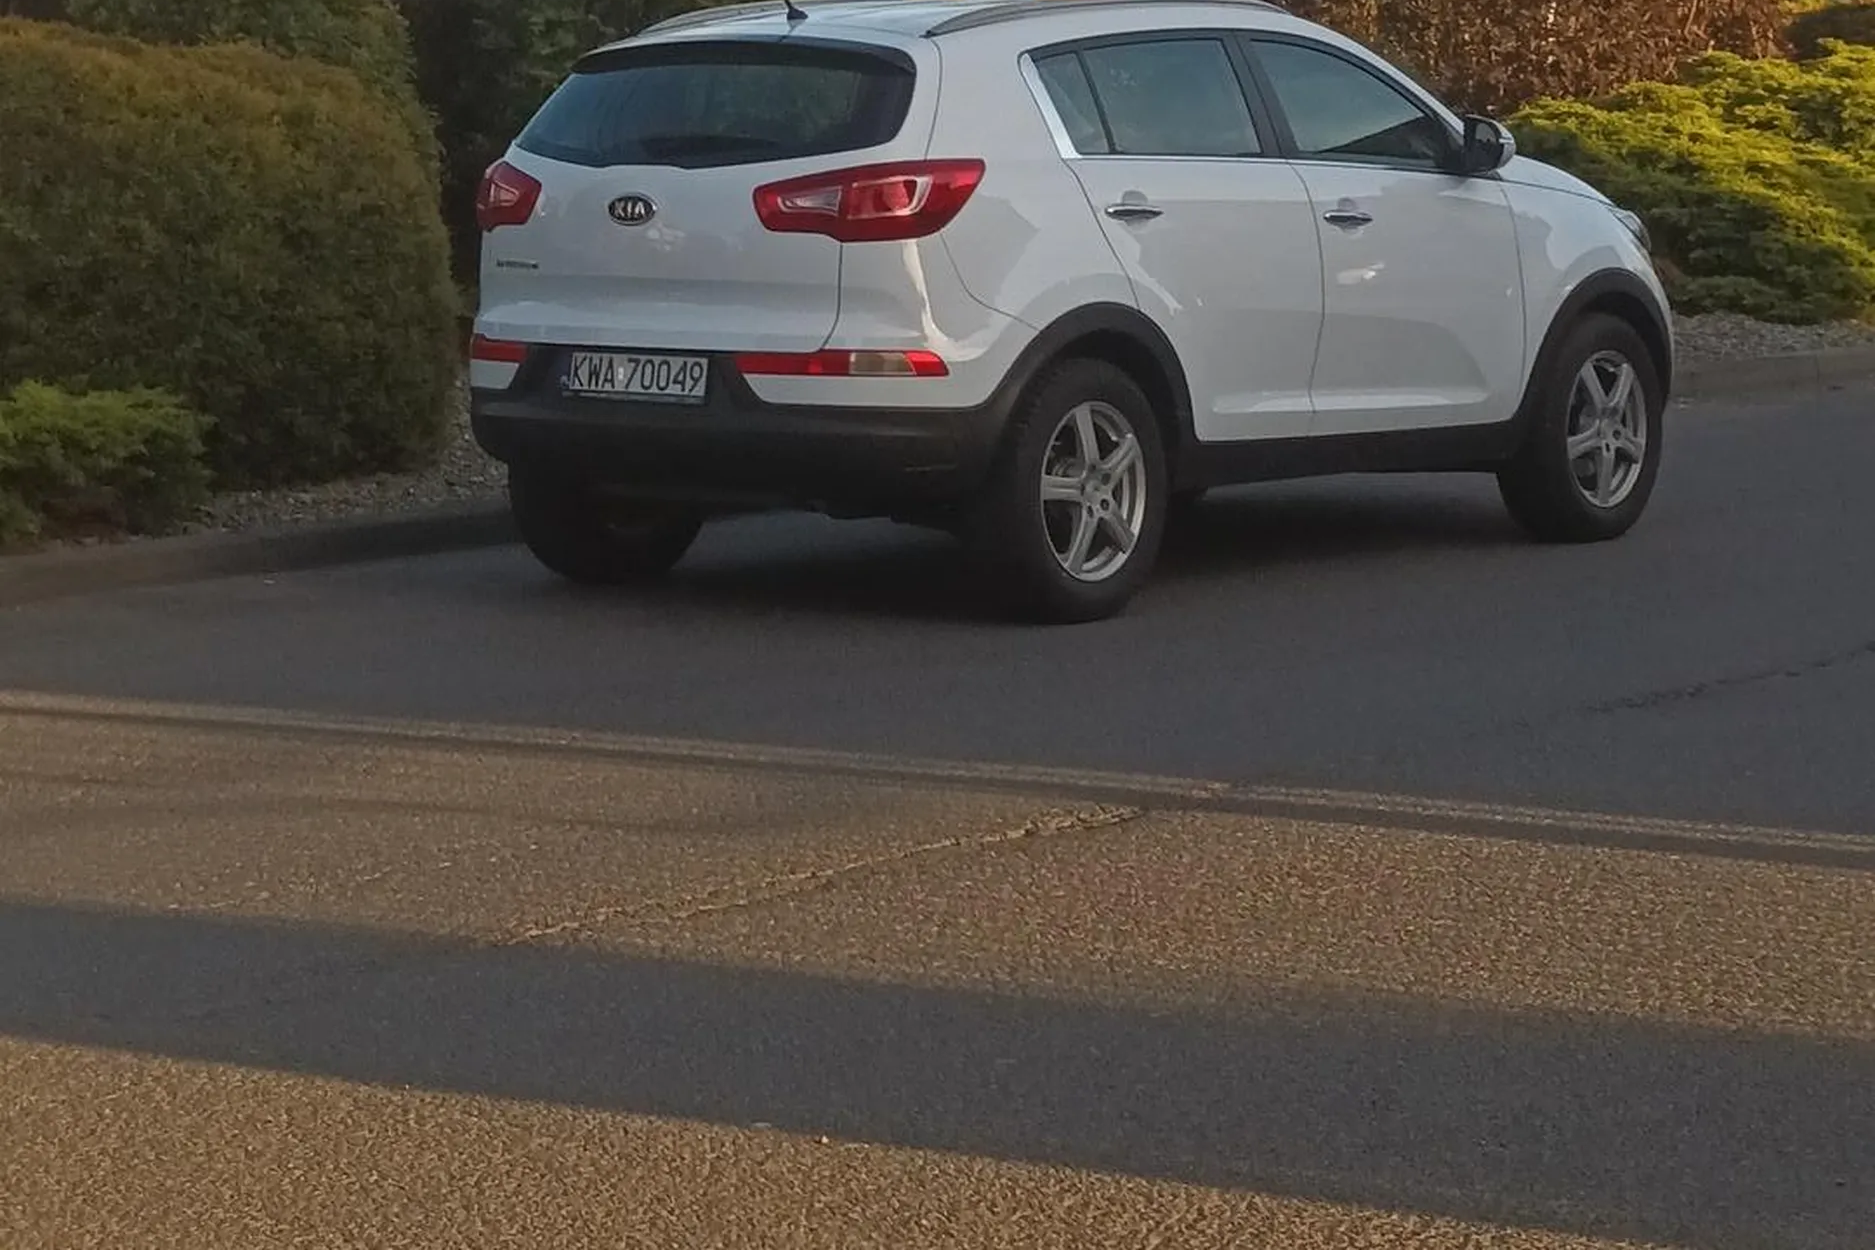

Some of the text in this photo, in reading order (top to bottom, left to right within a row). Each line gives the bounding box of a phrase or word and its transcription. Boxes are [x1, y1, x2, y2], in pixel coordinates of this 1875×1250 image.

[614, 201, 646, 219] KIA
[572, 354, 704, 395] KWA 70049
